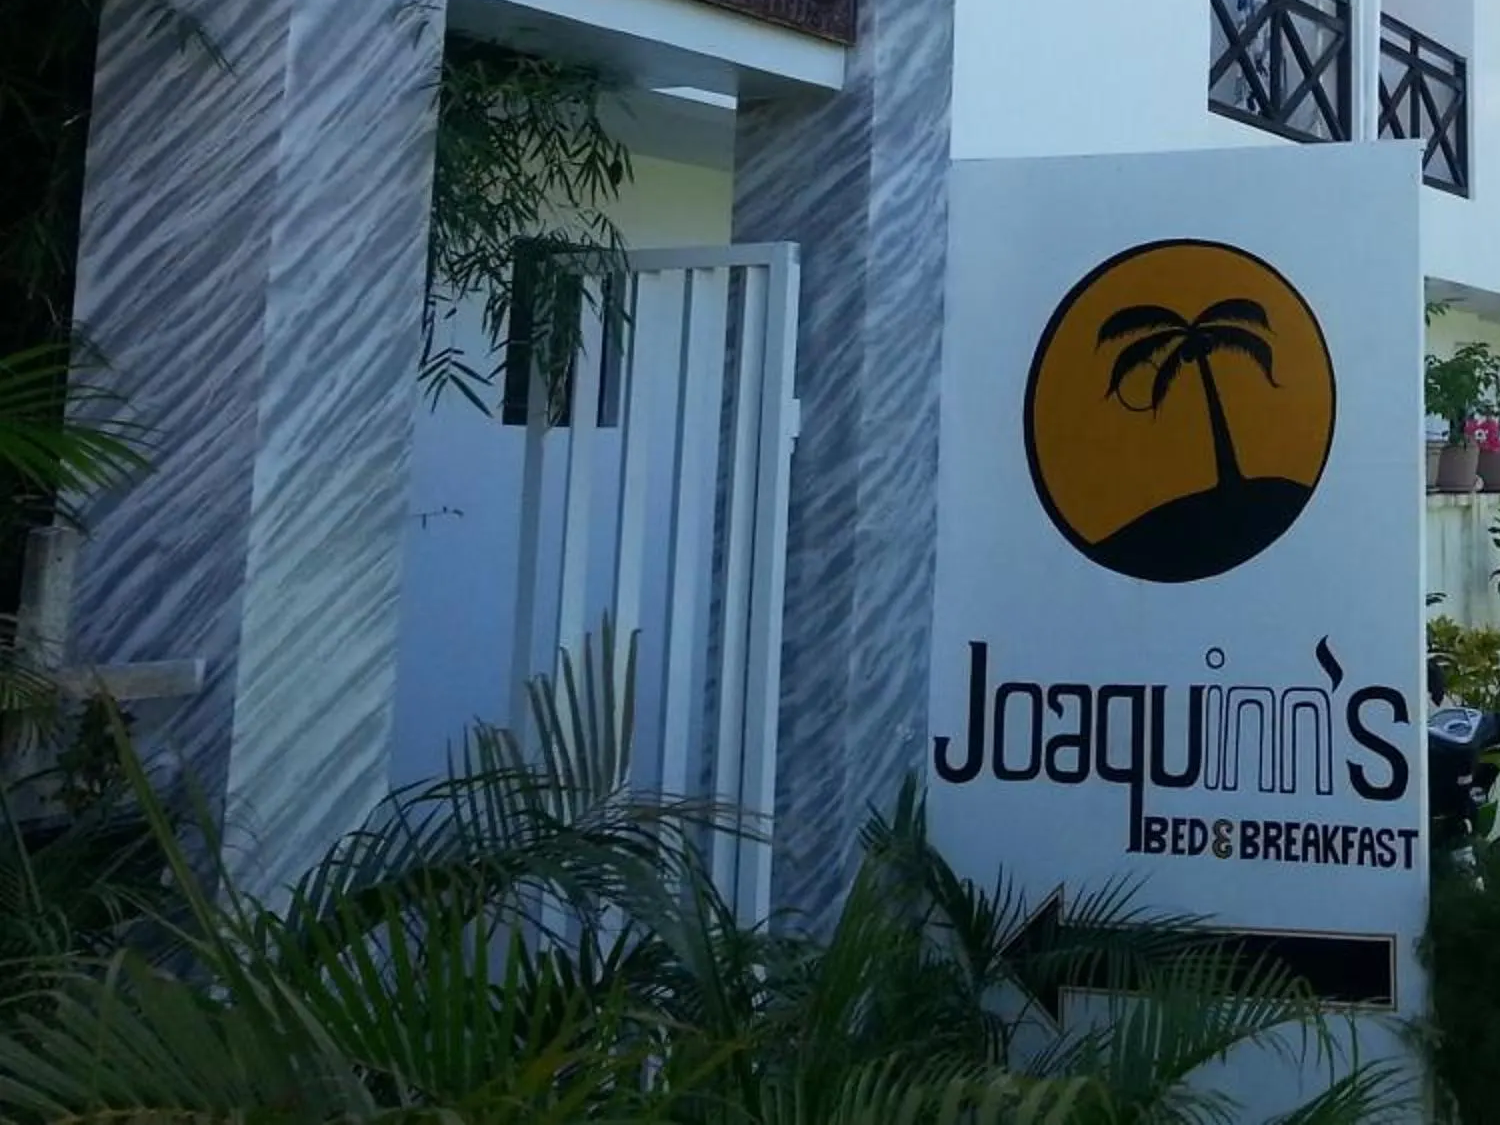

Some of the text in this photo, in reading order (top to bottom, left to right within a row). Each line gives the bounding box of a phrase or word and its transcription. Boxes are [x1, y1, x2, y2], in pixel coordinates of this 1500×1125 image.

[934, 635, 1410, 853] Joaquinn's
[1144, 816, 1208, 855] BED
[1240, 821, 1419, 869] BREAKFAST
